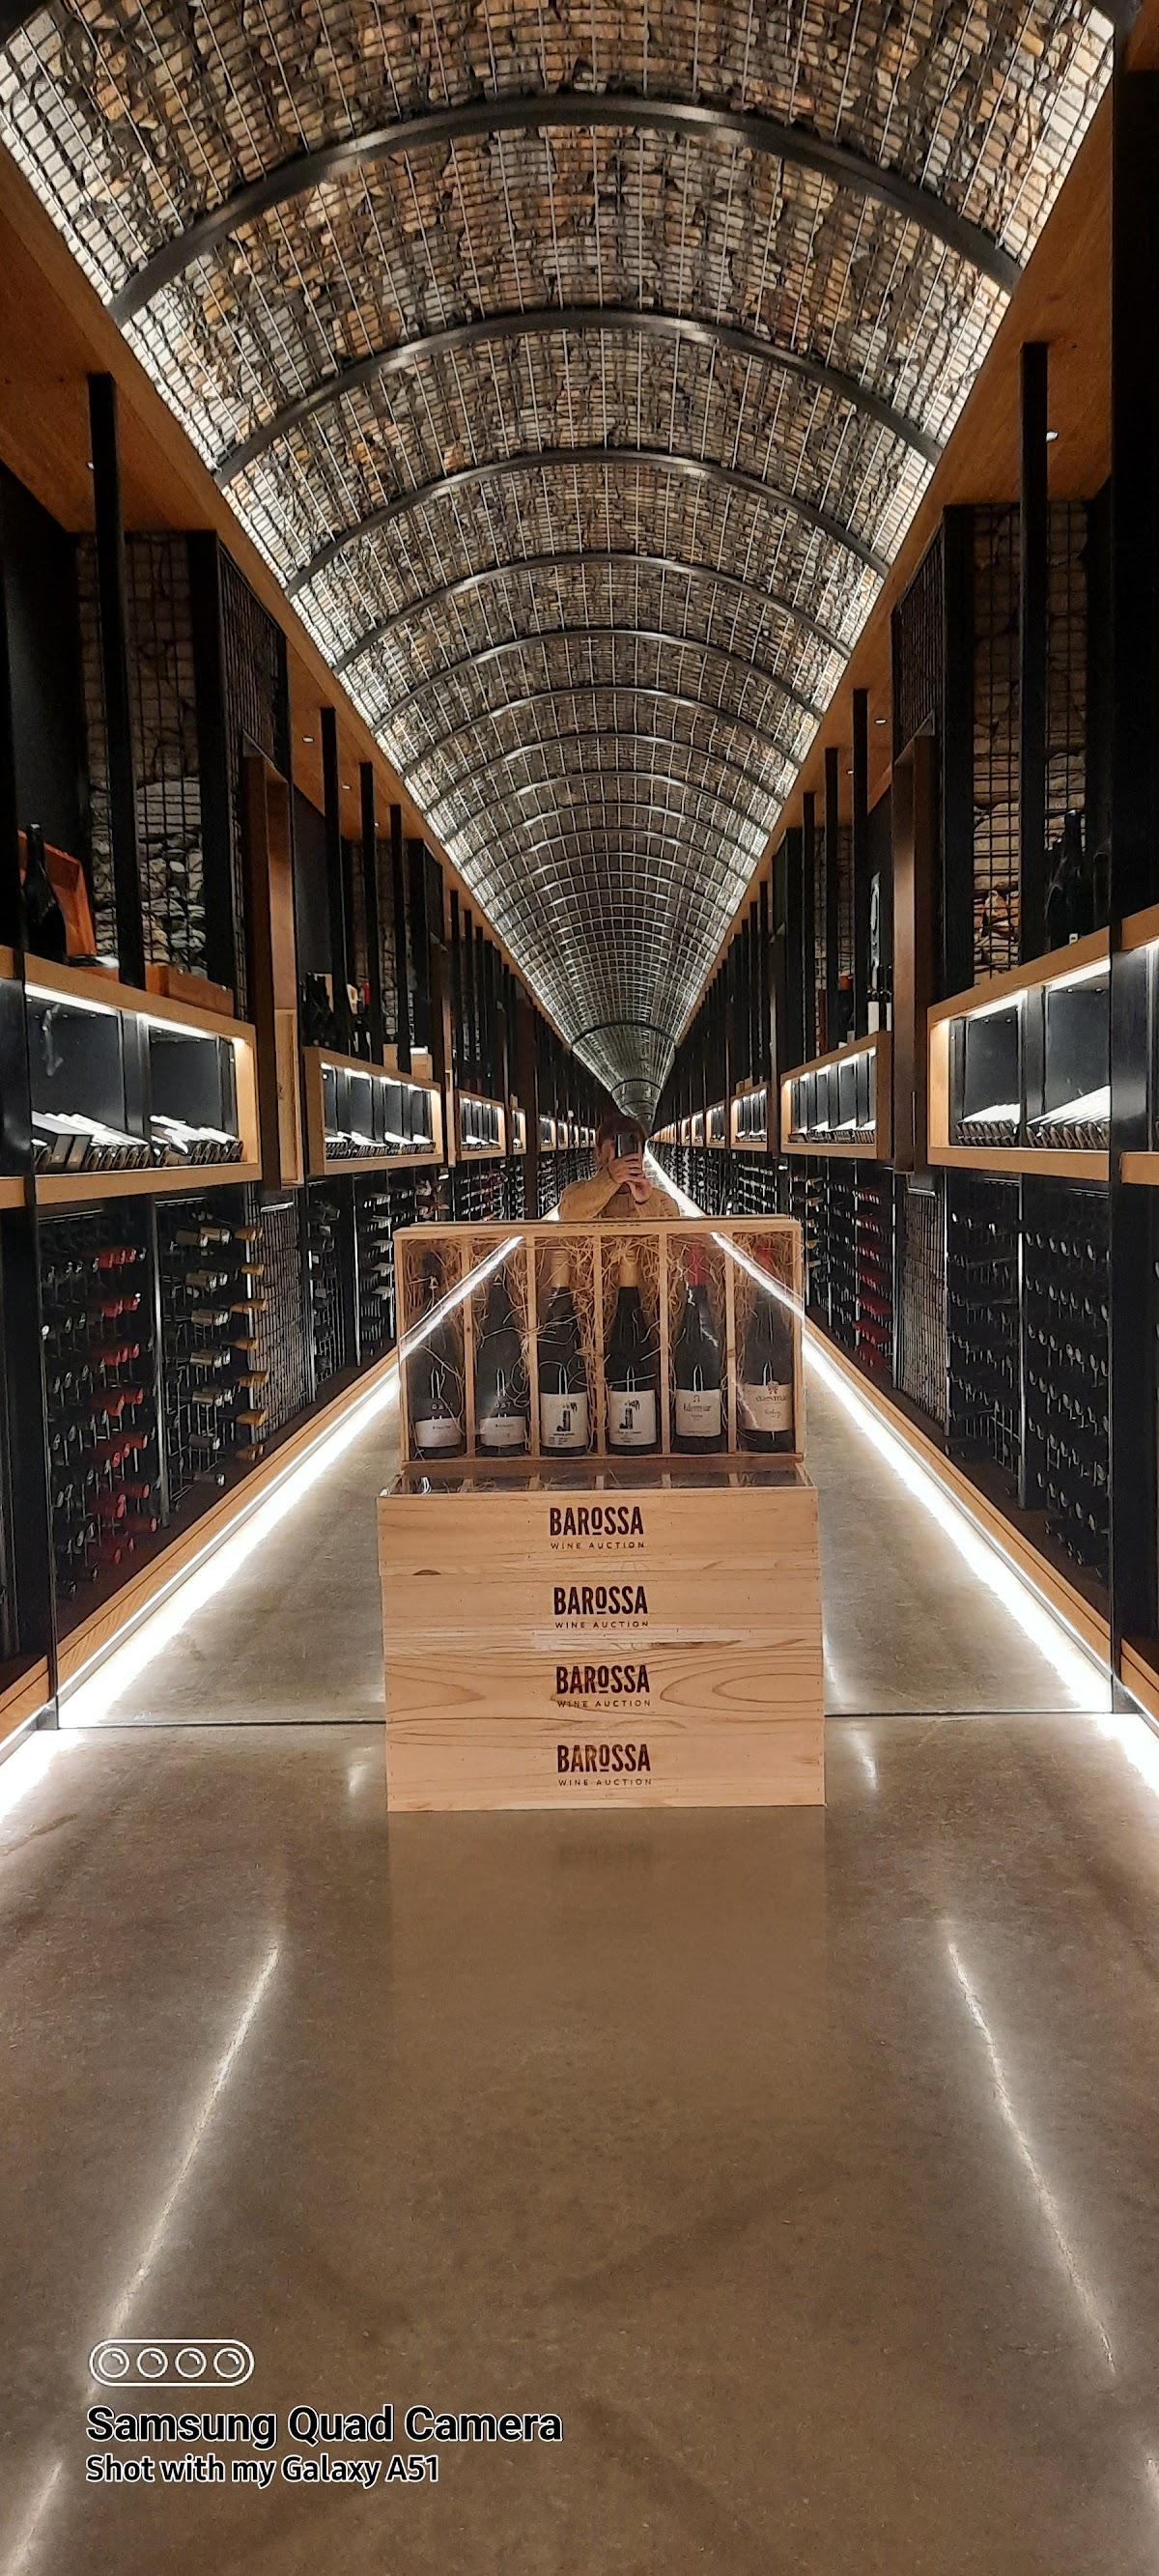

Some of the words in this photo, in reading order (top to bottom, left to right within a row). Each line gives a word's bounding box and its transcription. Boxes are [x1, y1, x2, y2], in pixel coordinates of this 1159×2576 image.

[550, 1506, 644, 1536] BAROSSA
[553, 1585, 648, 1615] BAROSSA
[556, 1664, 650, 1694] BAROSSA
[557, 1743, 651, 1772] BAROSSA
